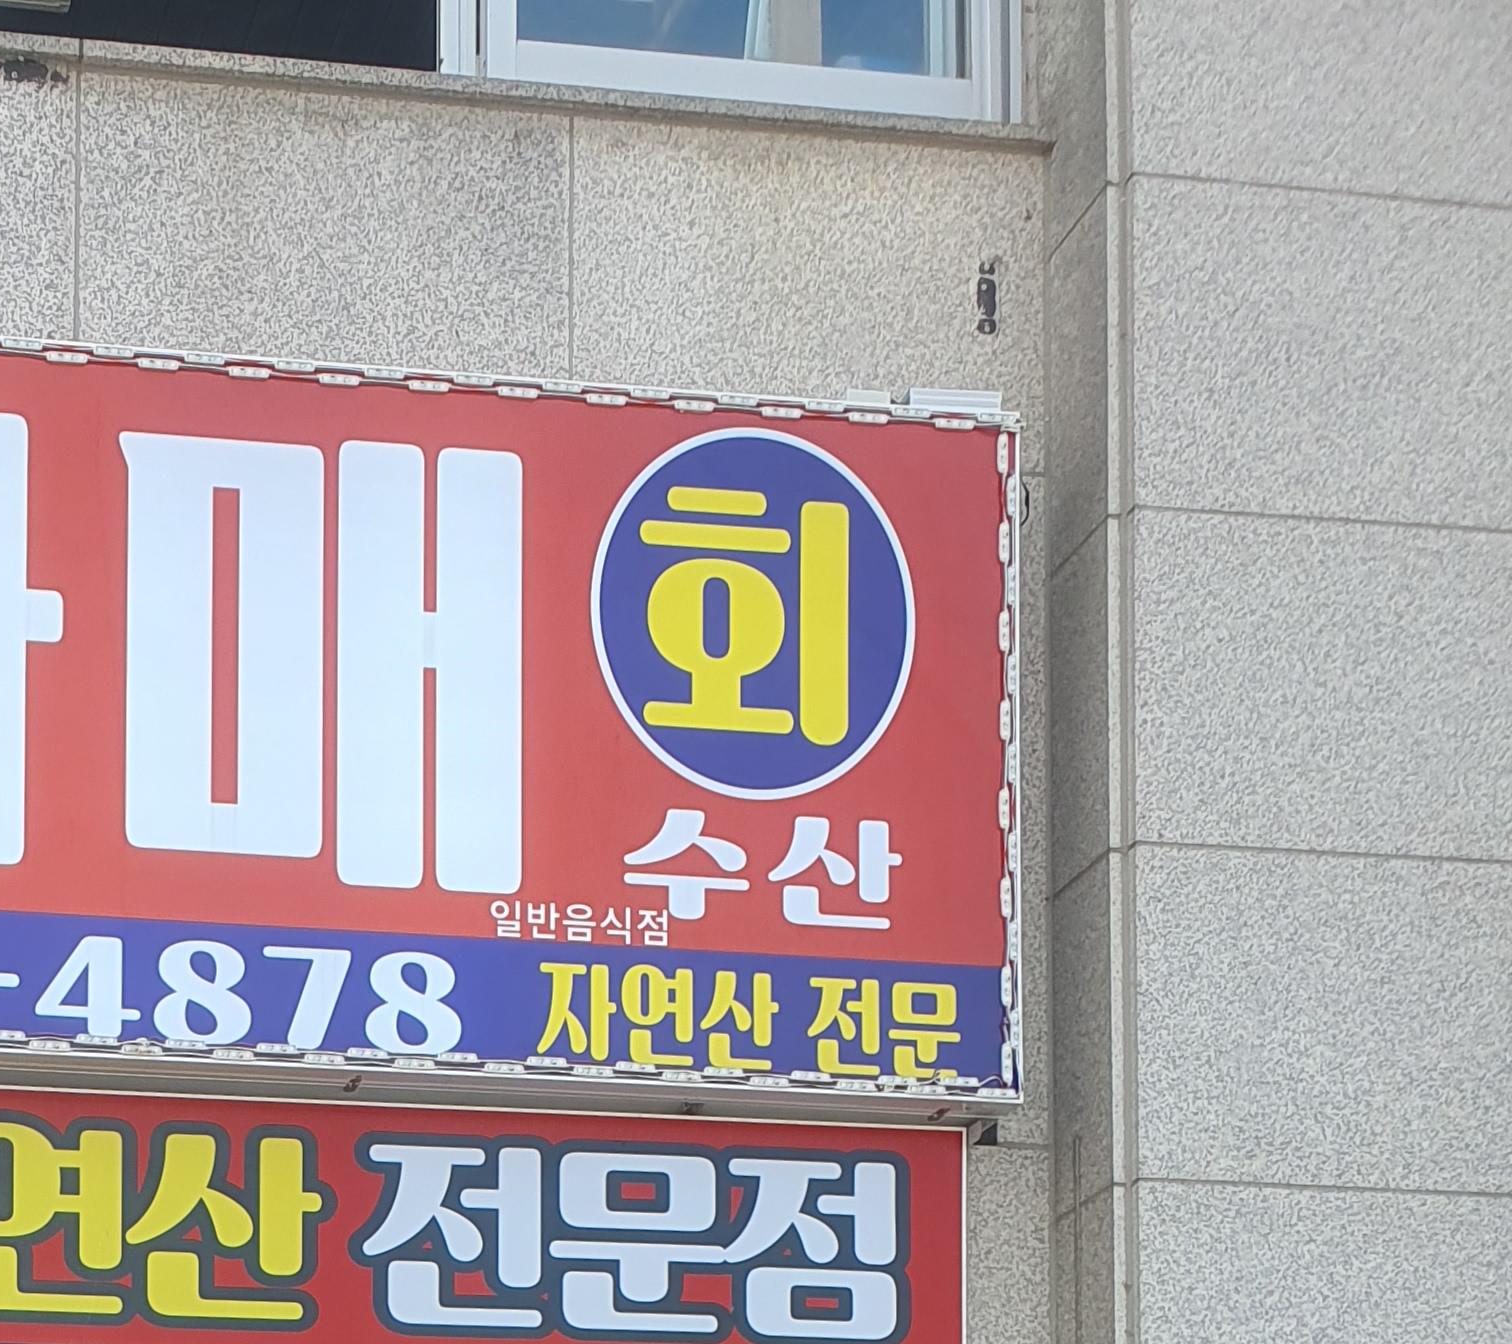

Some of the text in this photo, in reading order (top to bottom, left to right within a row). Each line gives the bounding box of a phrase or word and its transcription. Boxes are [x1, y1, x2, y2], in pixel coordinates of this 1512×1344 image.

[639, 485, 849, 745] 회
[489, 900, 670, 946] 일반음식점
[624, 808, 902, 929] 수산
[537, 962, 961, 1079] 자연산 전문
[363, 1144, 897, 1340] 전문점
